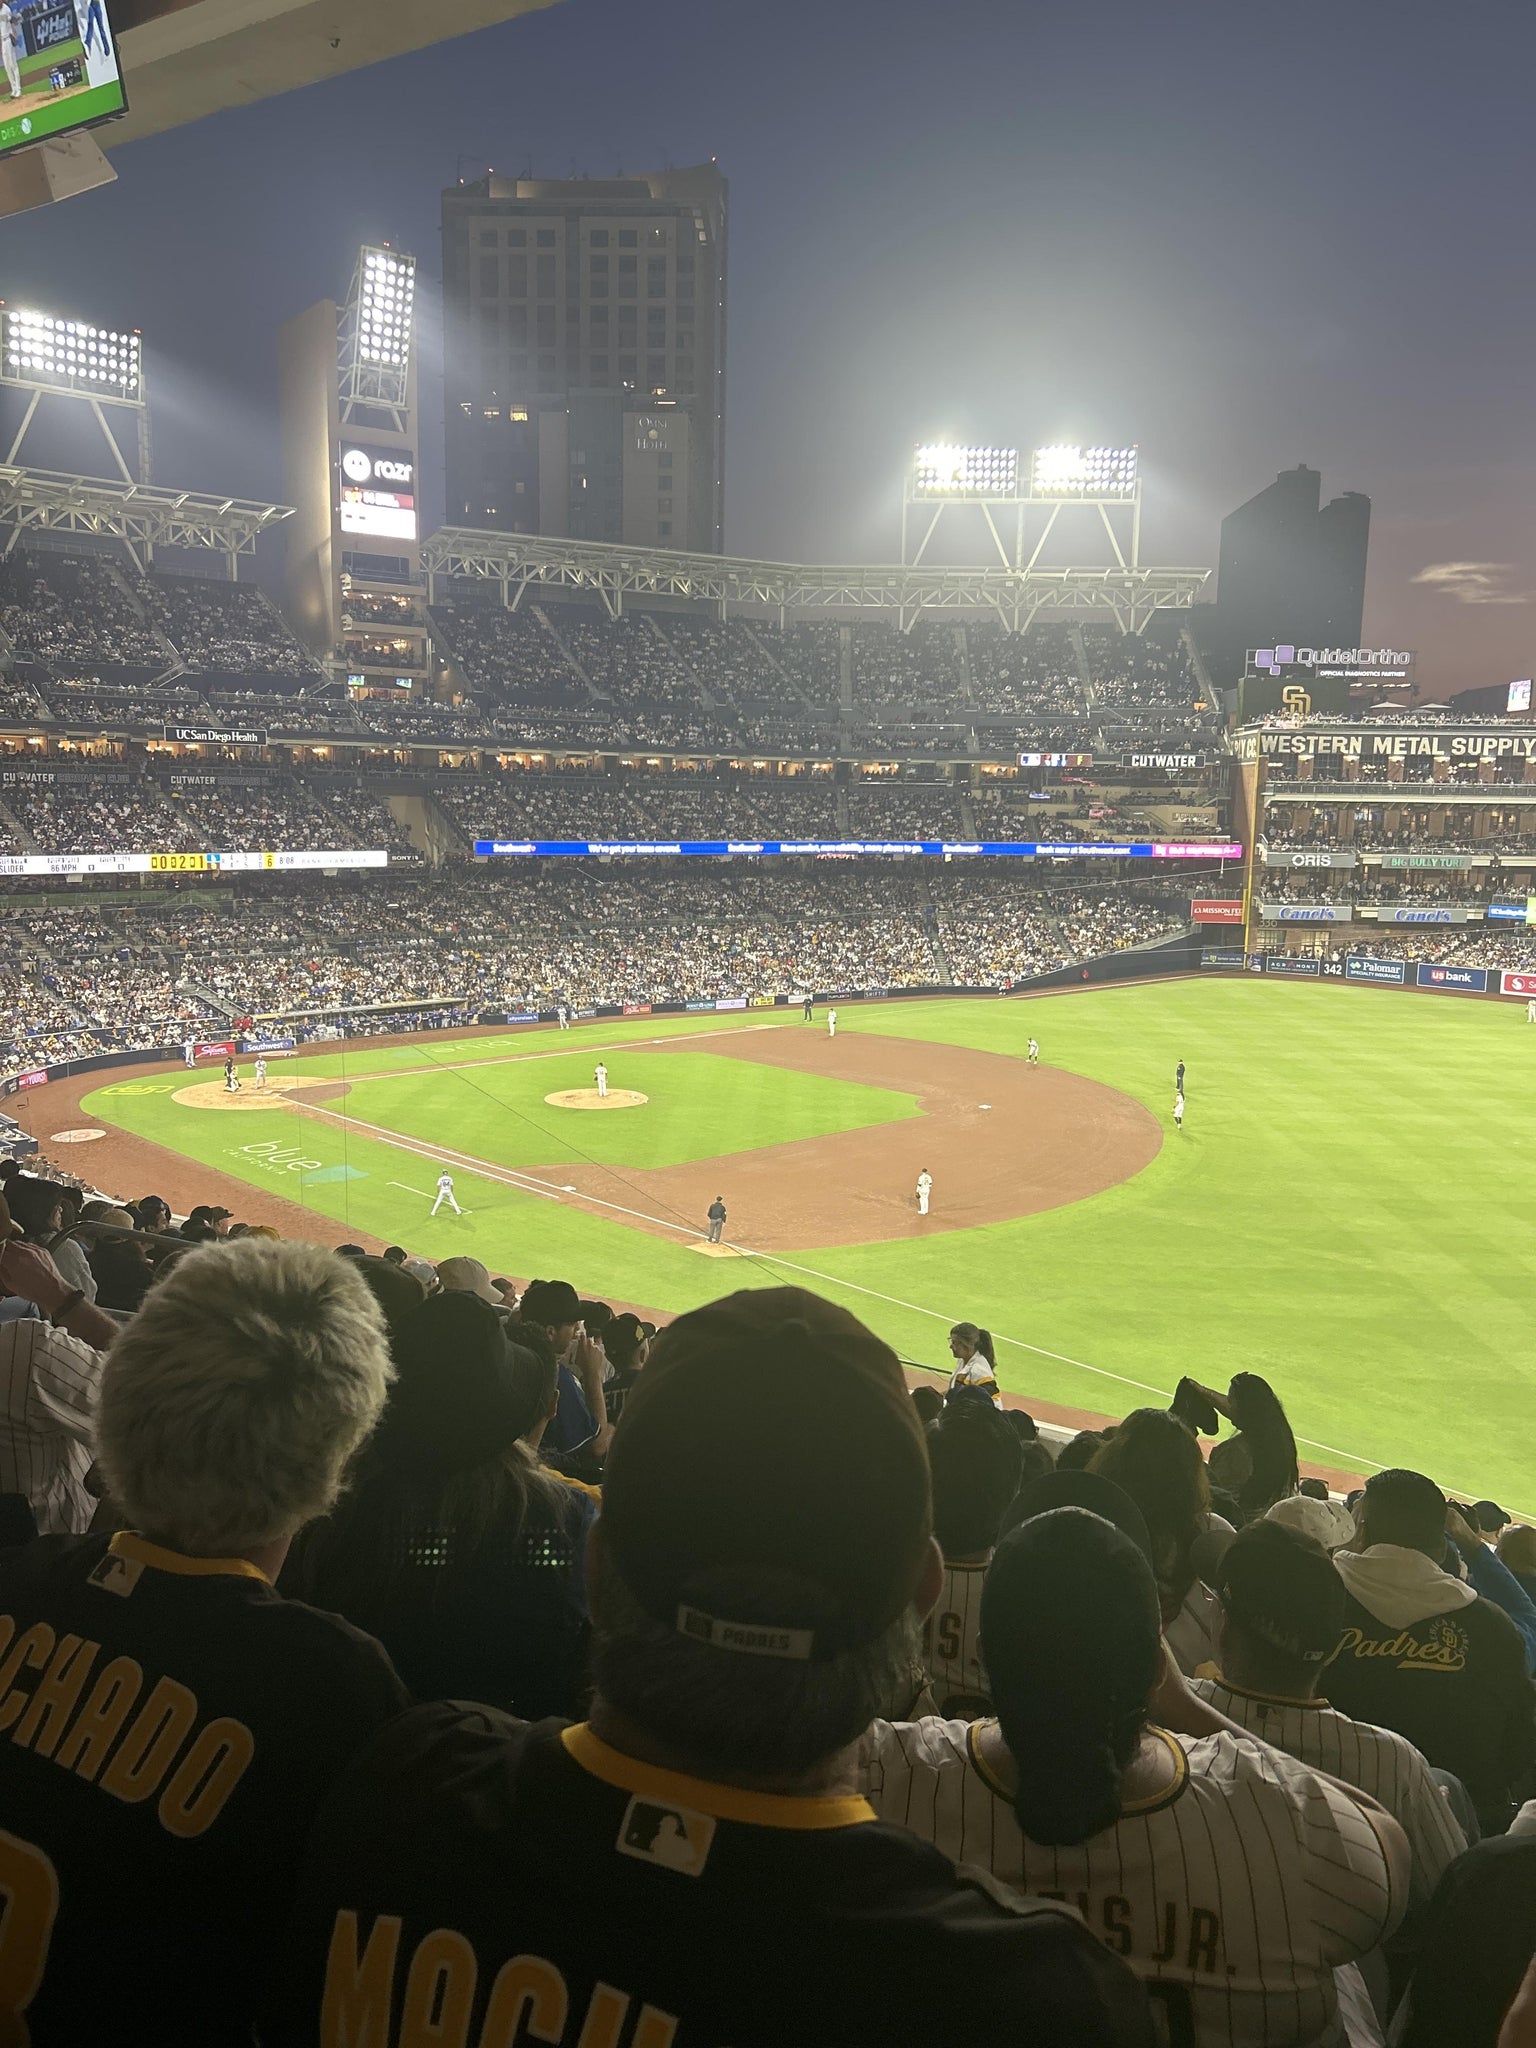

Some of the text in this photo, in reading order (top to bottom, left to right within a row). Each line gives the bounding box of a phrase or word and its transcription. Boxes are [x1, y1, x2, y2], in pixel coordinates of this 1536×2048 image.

[1297, 647, 1411, 667] QuidelOrtho
[176, 729, 258, 742] UC San Diego Health
[1261, 735, 1536, 756] WESTERN METAL SUPPLY
[1131, 755, 1196, 767] CUTWATER
[3, 772, 54, 783] CUWATER
[170, 775, 216, 785] CUTWATER
[1291, 854, 1332, 867] ORIS
[1391, 857, 1407, 866] BIG
[1410, 858, 1438, 867] BULLY
[1279, 906, 1336, 920] Canel's
[1395, 909, 1451, 922] Canel's
[1323, 963, 1342, 975] 342
[1363, 961, 1401, 973] Palomar
[1431, 971, 1472, 983] us bank
[247, 1042, 284, 1052] Southwest
[238, 1140, 322, 1171] blue
[723, 1627, 791, 1649] PADRES
[1324, 1627, 1466, 1671] Padres
[0, 1614, 254, 1838] CHADO
[1150, 1902, 1236, 1976] JR.
